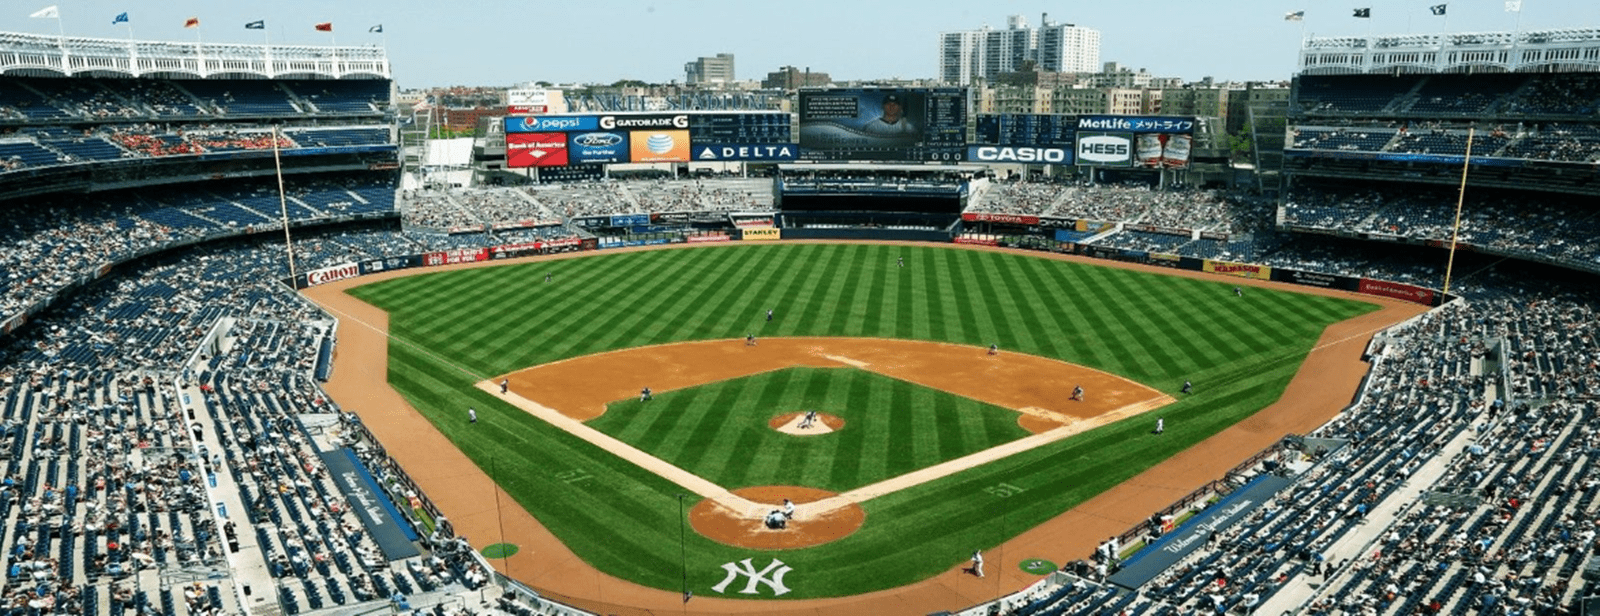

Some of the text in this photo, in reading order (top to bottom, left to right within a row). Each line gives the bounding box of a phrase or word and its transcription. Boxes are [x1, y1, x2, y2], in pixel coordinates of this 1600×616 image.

[563, 96, 646, 111] YANKEE
[666, 95, 767, 111] STADIUM
[542, 117, 580, 128] pepsi
[617, 118, 672, 127] GATORADE
[1078, 118, 1193, 130] MetLife メットライフ
[582, 136, 613, 146] Ford
[722, 146, 792, 158] DELTA
[1081, 142, 1128, 155] HESS
[977, 147, 1065, 163] CASIO
[990, 215, 1022, 223] TOYOTA
[1039, 219, 1076, 228] DKNY
[308, 266, 358, 285] Canon
[1163, 532, 1200, 553] Welcome
